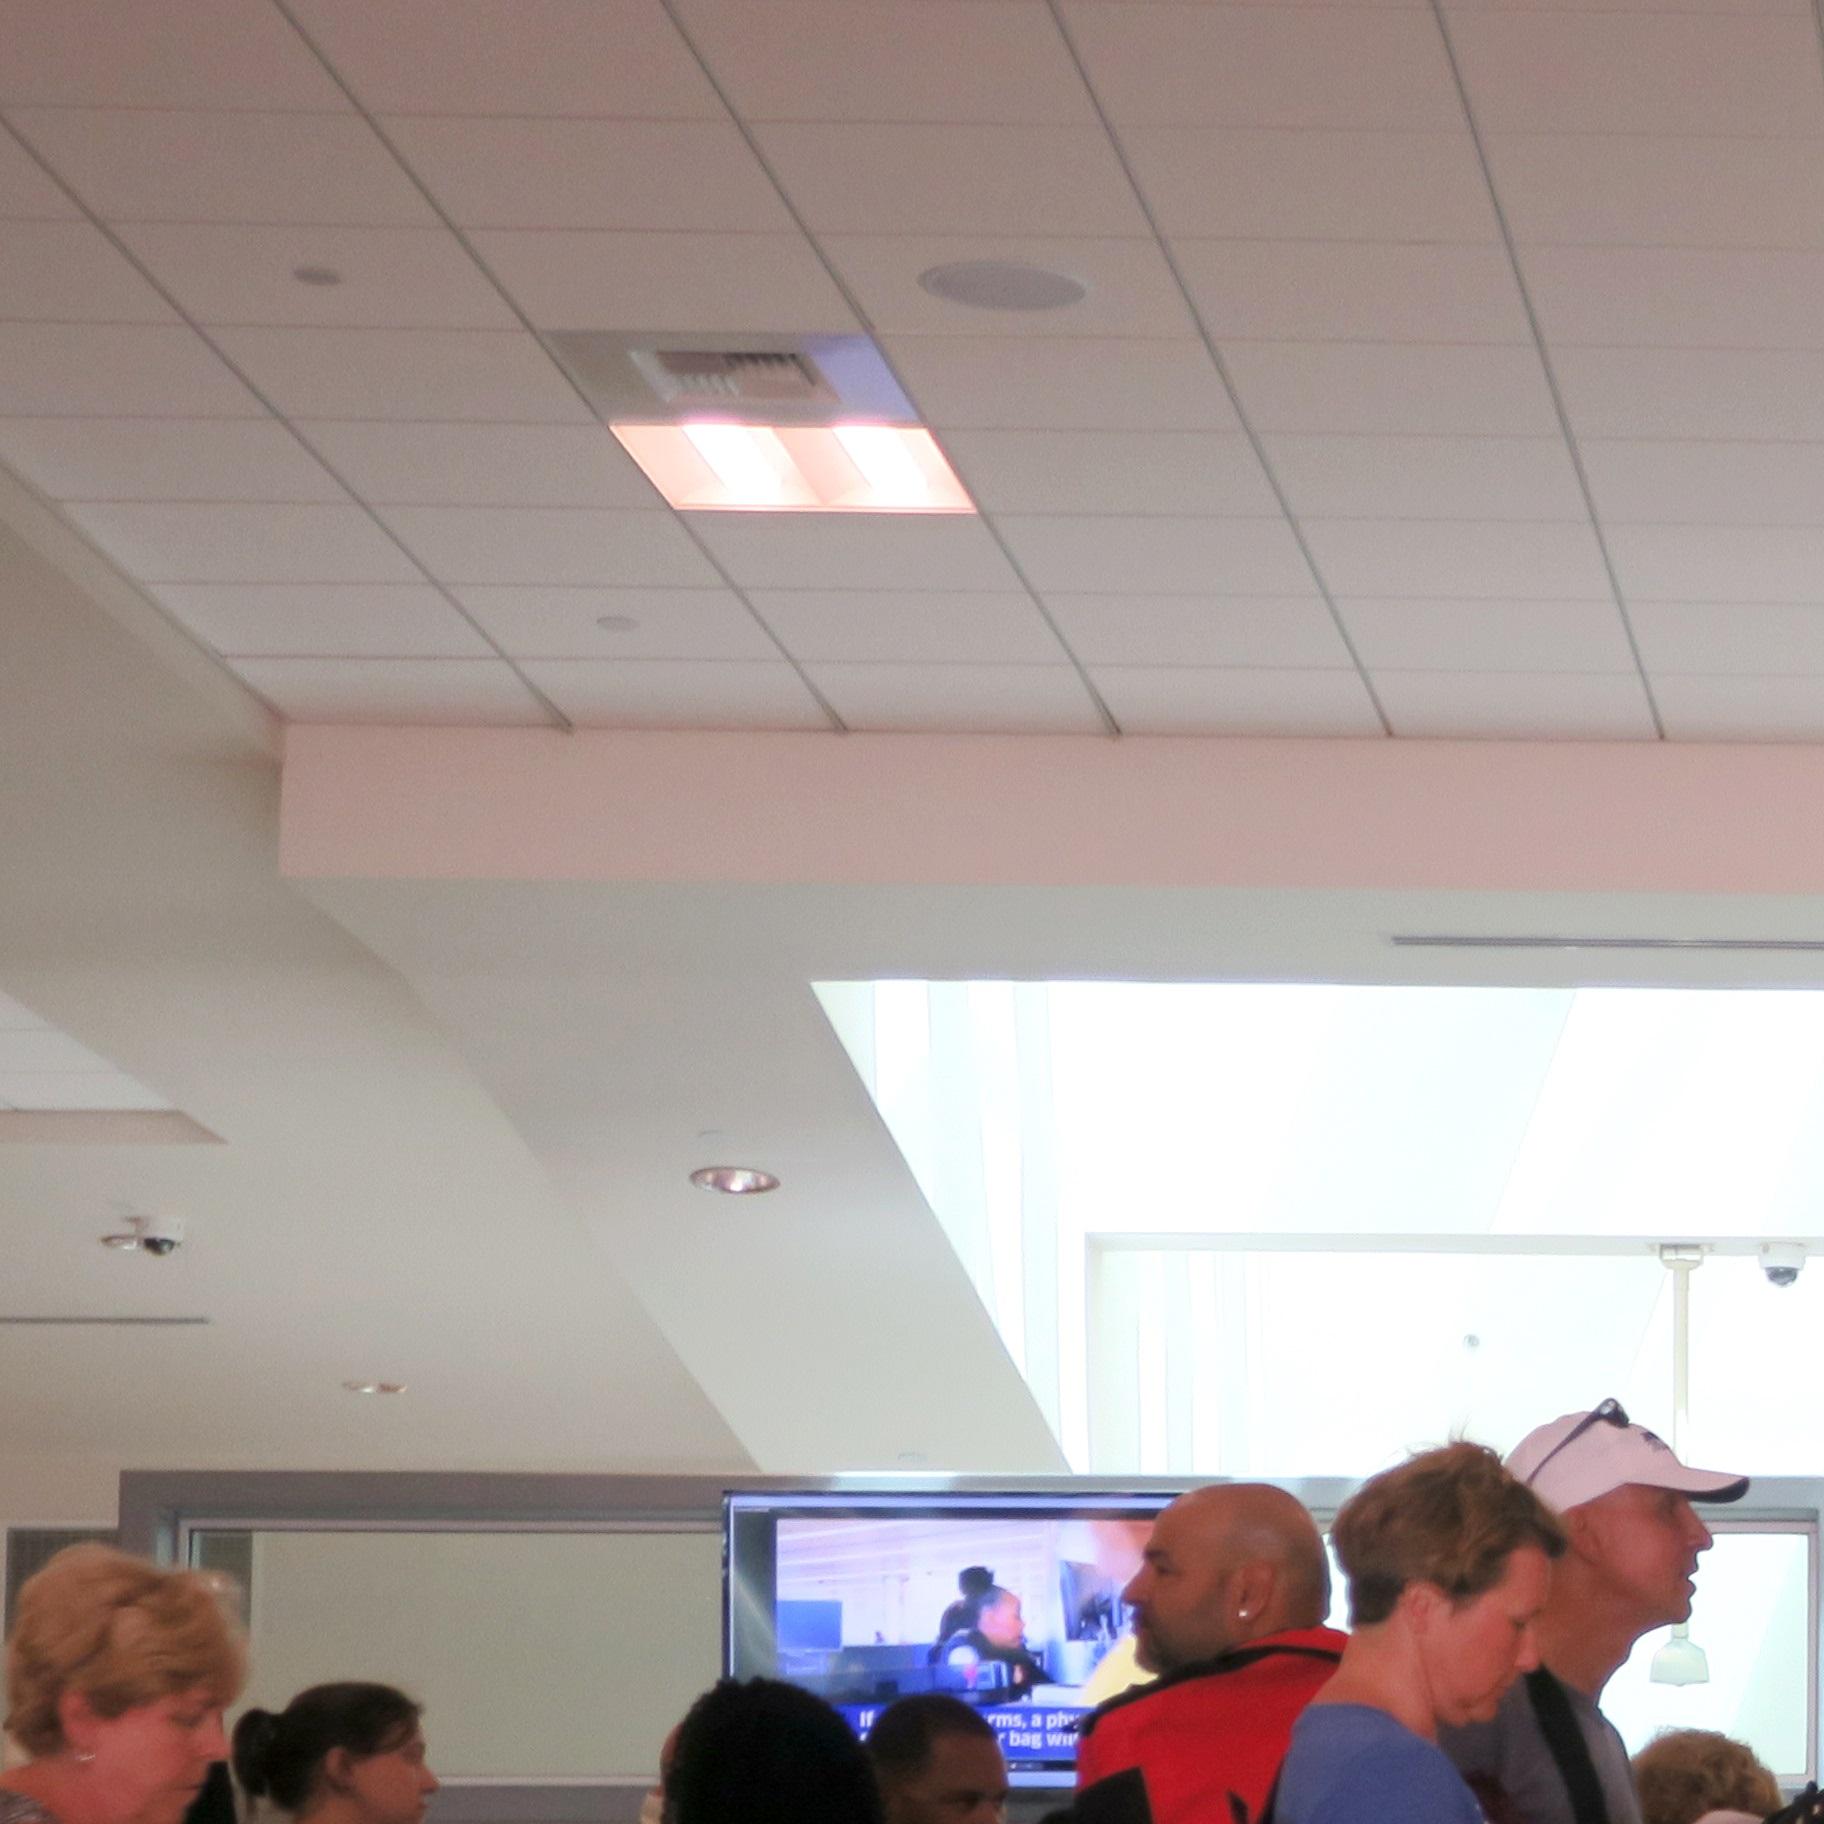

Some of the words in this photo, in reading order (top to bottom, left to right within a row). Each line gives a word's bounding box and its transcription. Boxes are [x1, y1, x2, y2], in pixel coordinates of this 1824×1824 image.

[858, 1711, 876, 1728] If
[986, 1713, 1028, 1728] rms,
[1031, 1717, 1042, 1727] a
[1009, 1731, 1042, 1749] bag
